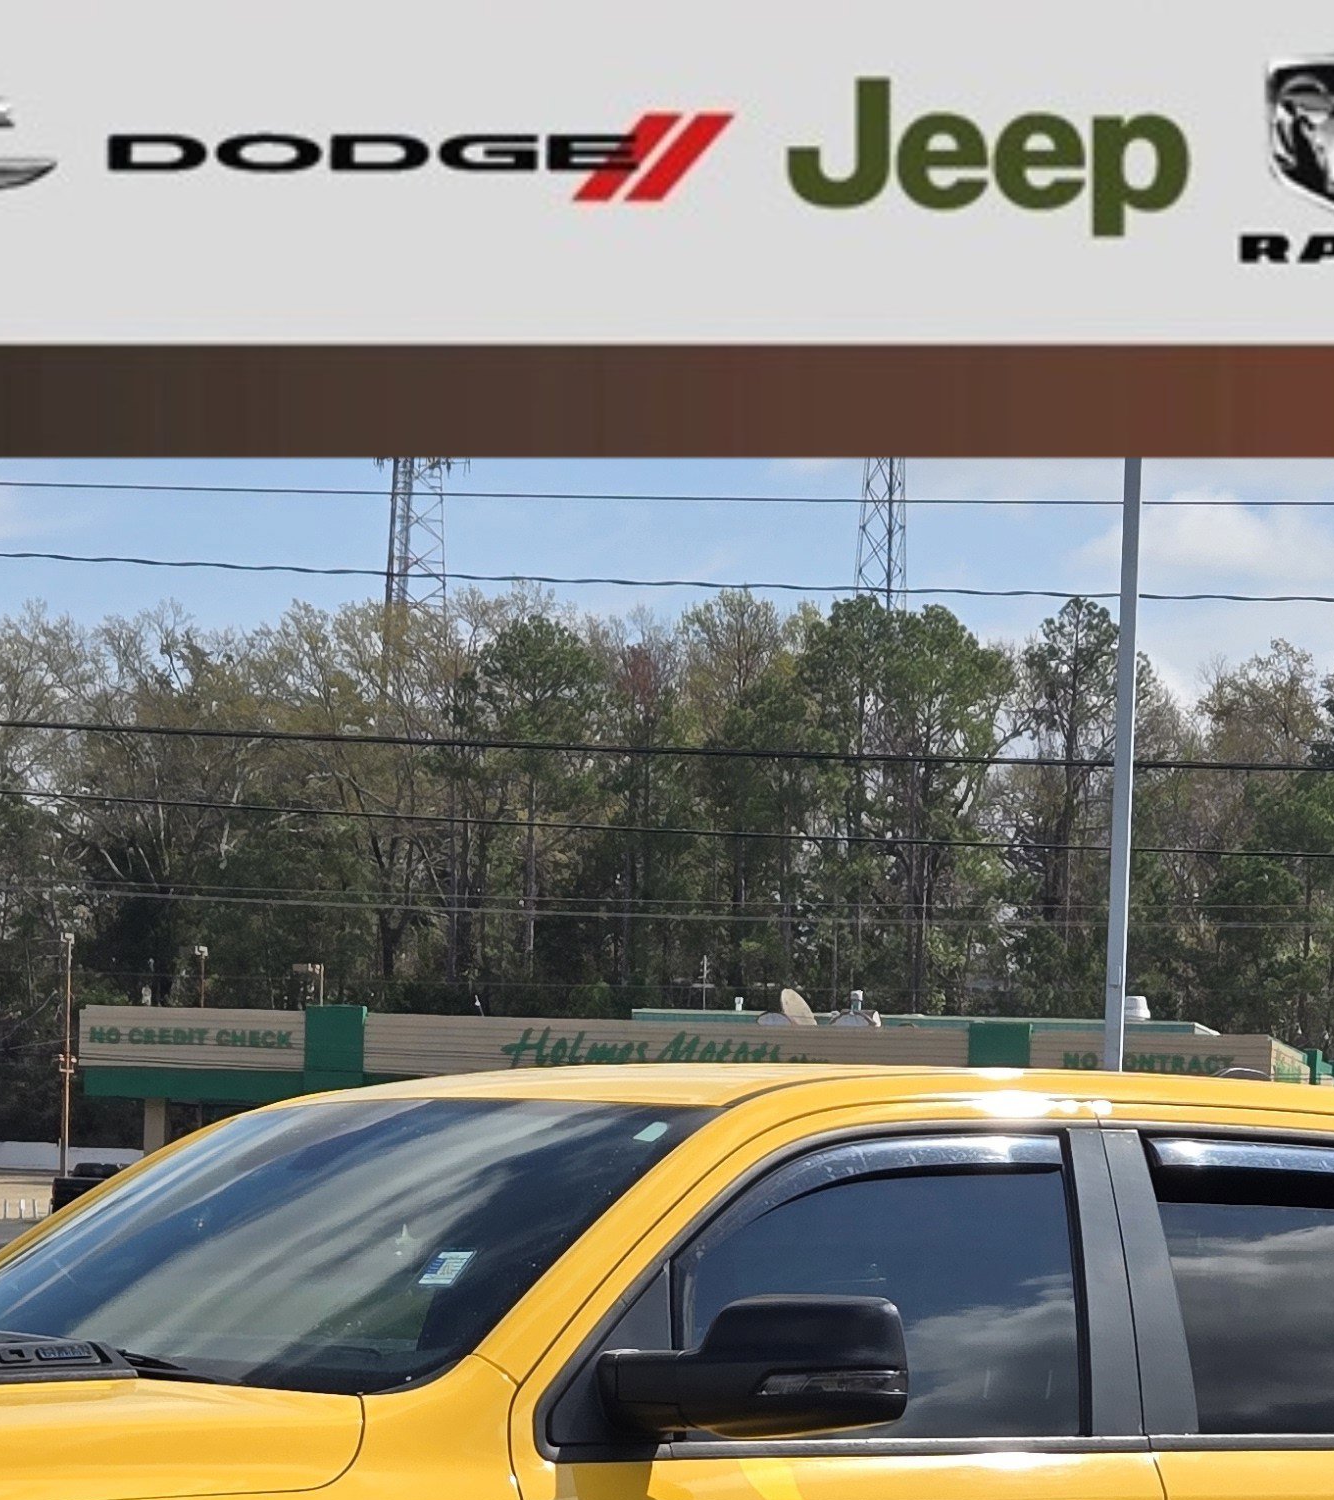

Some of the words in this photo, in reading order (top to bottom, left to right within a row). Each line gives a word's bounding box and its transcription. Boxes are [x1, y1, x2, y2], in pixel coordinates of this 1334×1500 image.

[89, 1026, 120, 1044] NO
[128, 1027, 209, 1046] CREDIT
[216, 1029, 293, 1048] CHECK
[500, 1025, 649, 1068] Holmes
[1062, 1052, 1099, 1070] NO
[1122, 1053, 1235, 1076] ONTRACT
